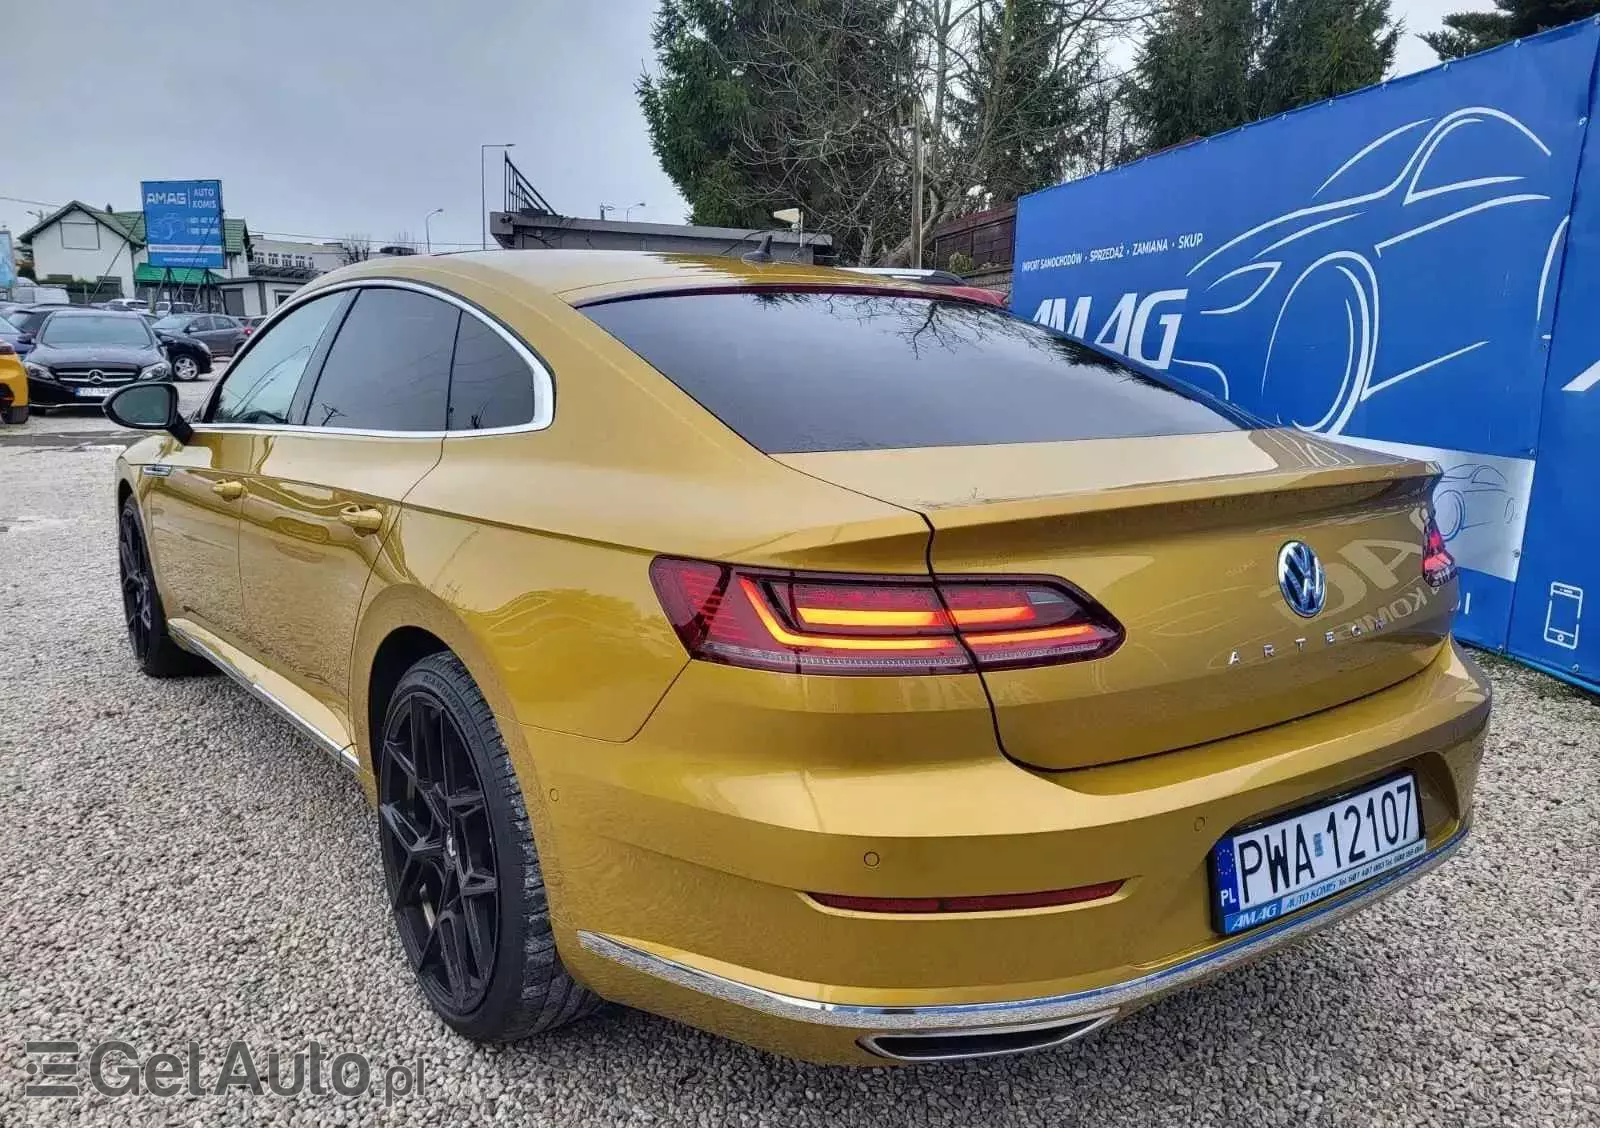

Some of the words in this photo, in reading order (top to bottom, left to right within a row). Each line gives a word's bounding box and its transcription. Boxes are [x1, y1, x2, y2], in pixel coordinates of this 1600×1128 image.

[146, 193, 186, 205] AMAG
[193, 188, 214, 197] AUTO
[1021, 260, 1040, 273] IMPORT
[1040, 253, 1083, 270] SAMOCHODÓW
[1089, 243, 1124, 262] SPRZEDAŻ
[1132, 239, 1168, 256] ZAMIANA
[1178, 233, 1203, 249] SKUP
[1238, 824, 1316, 904] PWA
[1326, 782, 1412, 869] 12107
[1221, 887, 1237, 907] PL
[1230, 903, 1278, 930] AMAG
